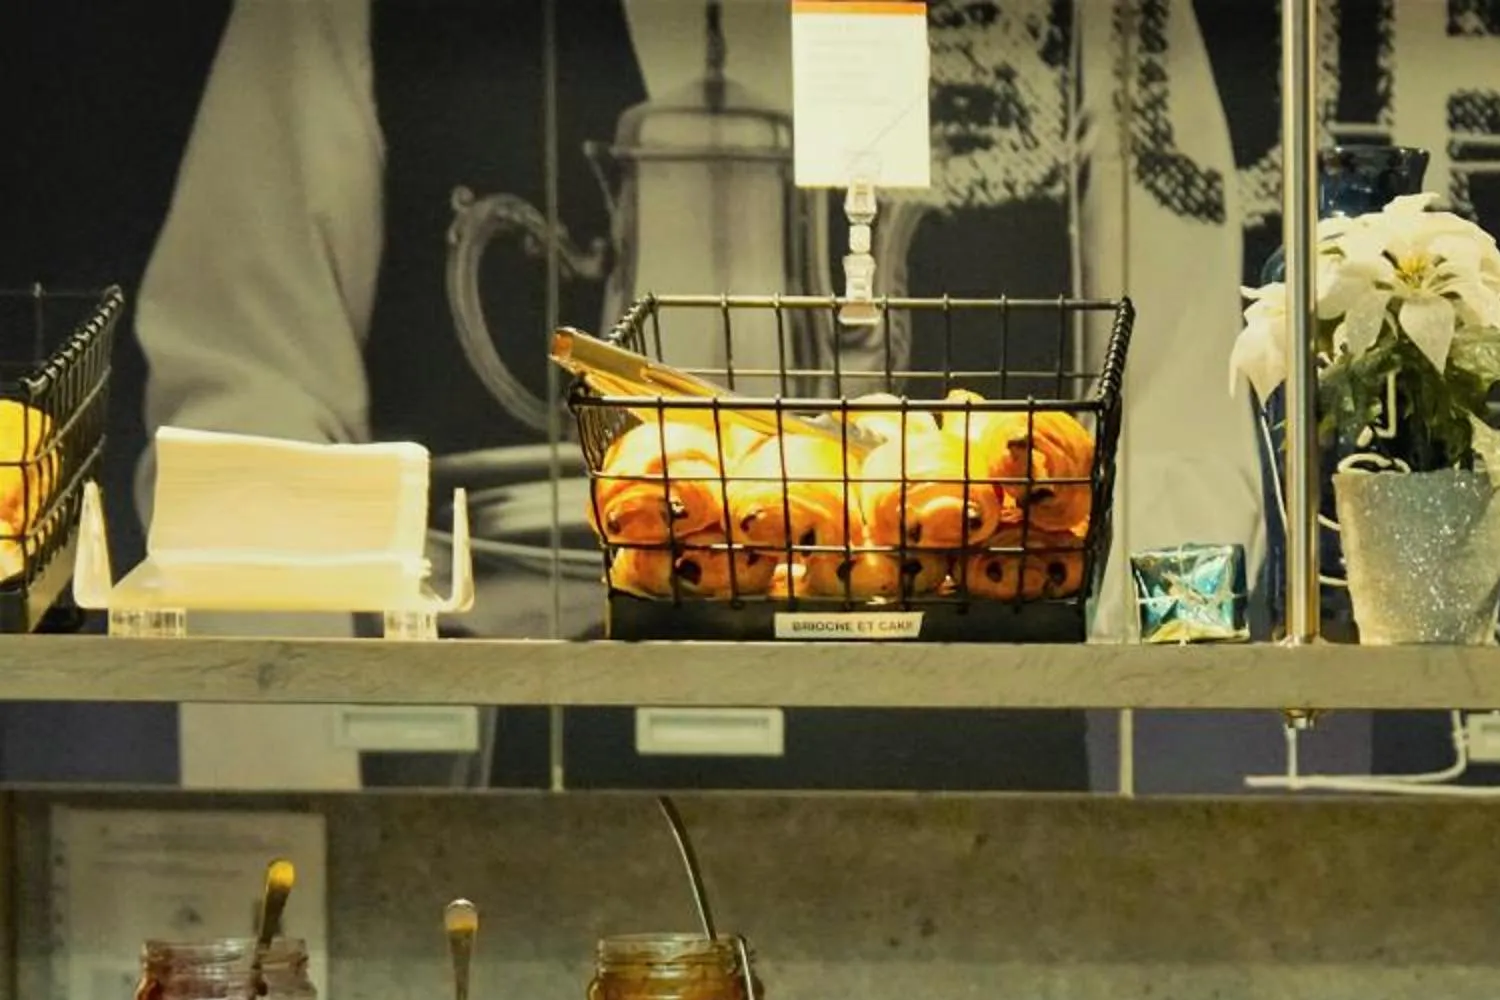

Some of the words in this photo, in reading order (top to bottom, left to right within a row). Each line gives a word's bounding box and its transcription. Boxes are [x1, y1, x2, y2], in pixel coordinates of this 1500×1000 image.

[792, 621, 850, 632] BRIOCHE
[857, 621, 874, 632] ET
[878, 620, 913, 631] CAKE
